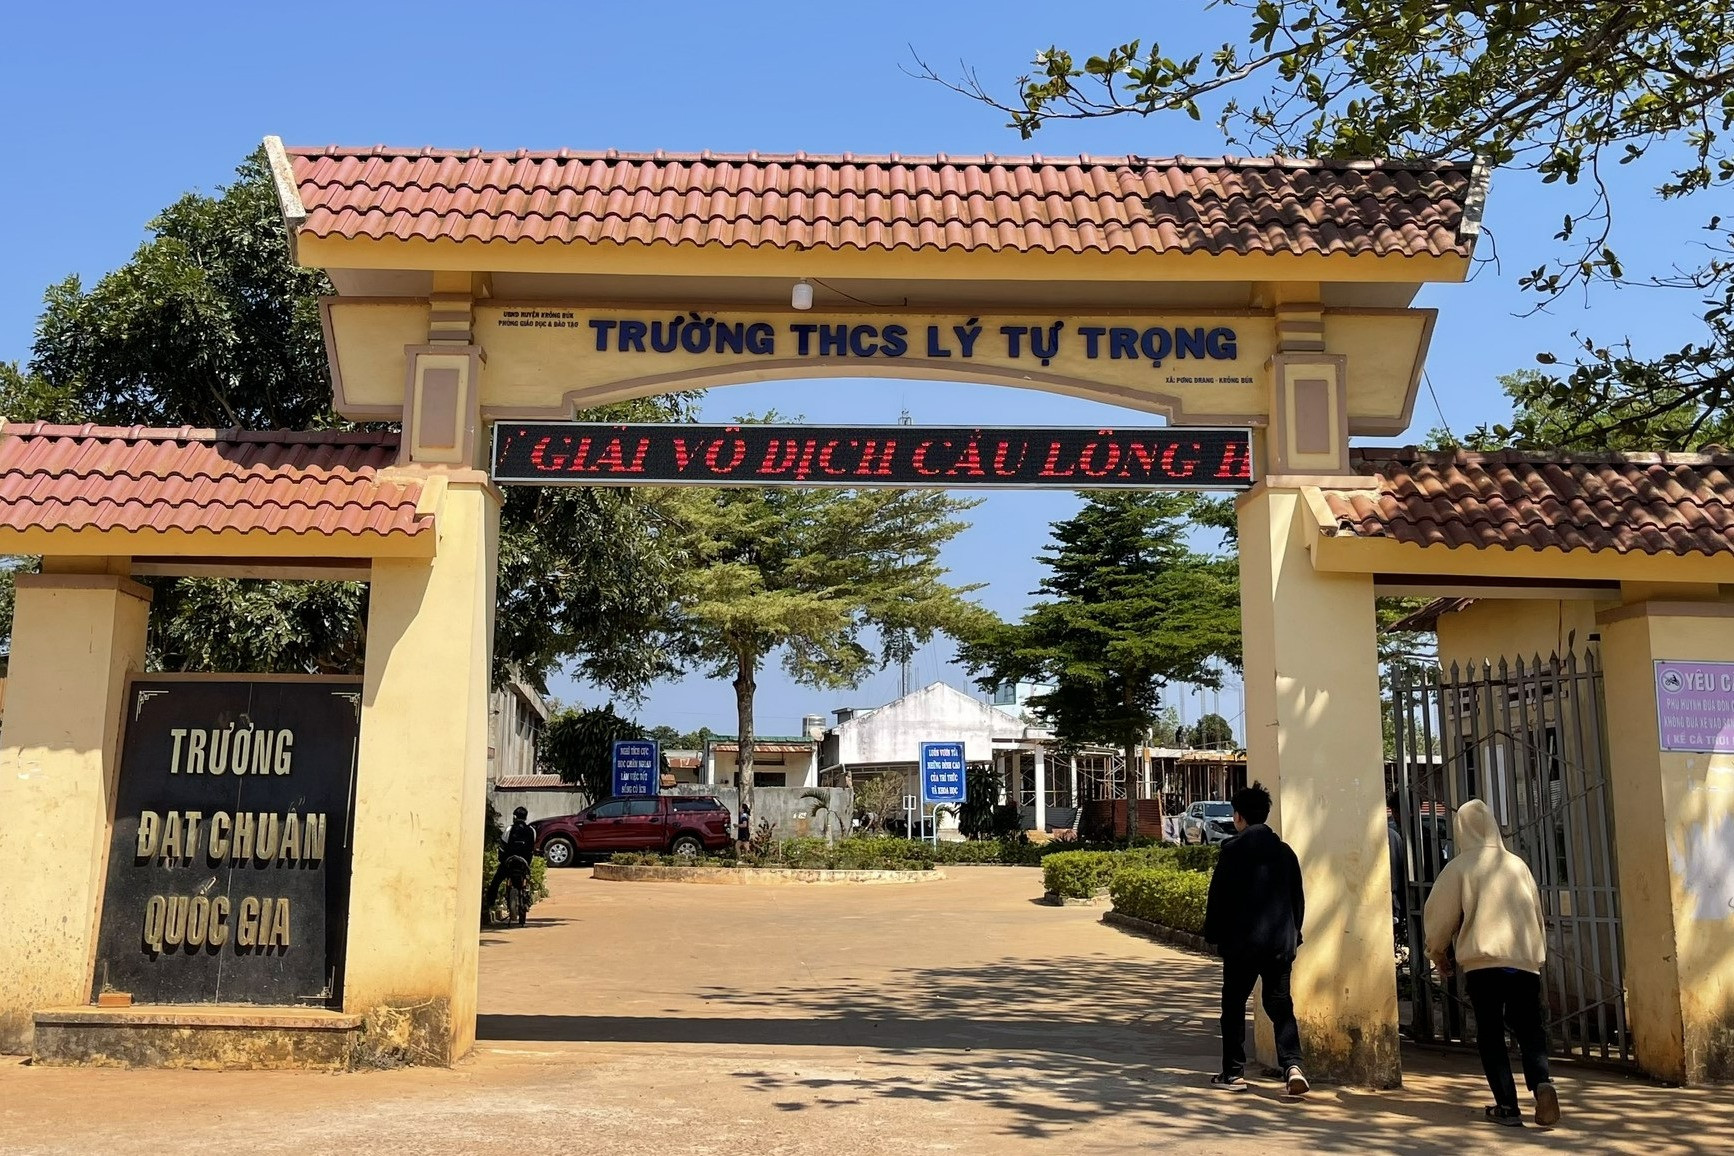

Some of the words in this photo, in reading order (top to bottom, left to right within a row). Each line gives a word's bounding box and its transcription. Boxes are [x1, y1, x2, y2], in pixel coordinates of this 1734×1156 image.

[520, 319, 534, 327] GIÁO
[535, 320, 547, 328] DỤC
[567, 321, 579, 329] TẠO
[589, 312, 775, 355] TRƯỜNG
[790, 324, 908, 357] THCS
[927, 317, 983, 357] LÝ
[1000, 320, 1064, 367] TỰ
[1077, 327, 1237, 368] TRỌNG
[673, 426, 747, 473] VÔ
[1038, 430, 1201, 478] LÔNG
[1685, 669, 1715, 691] YÊU
[1721, 671, 1734, 692] C
[237, 896, 290, 947] GIA
